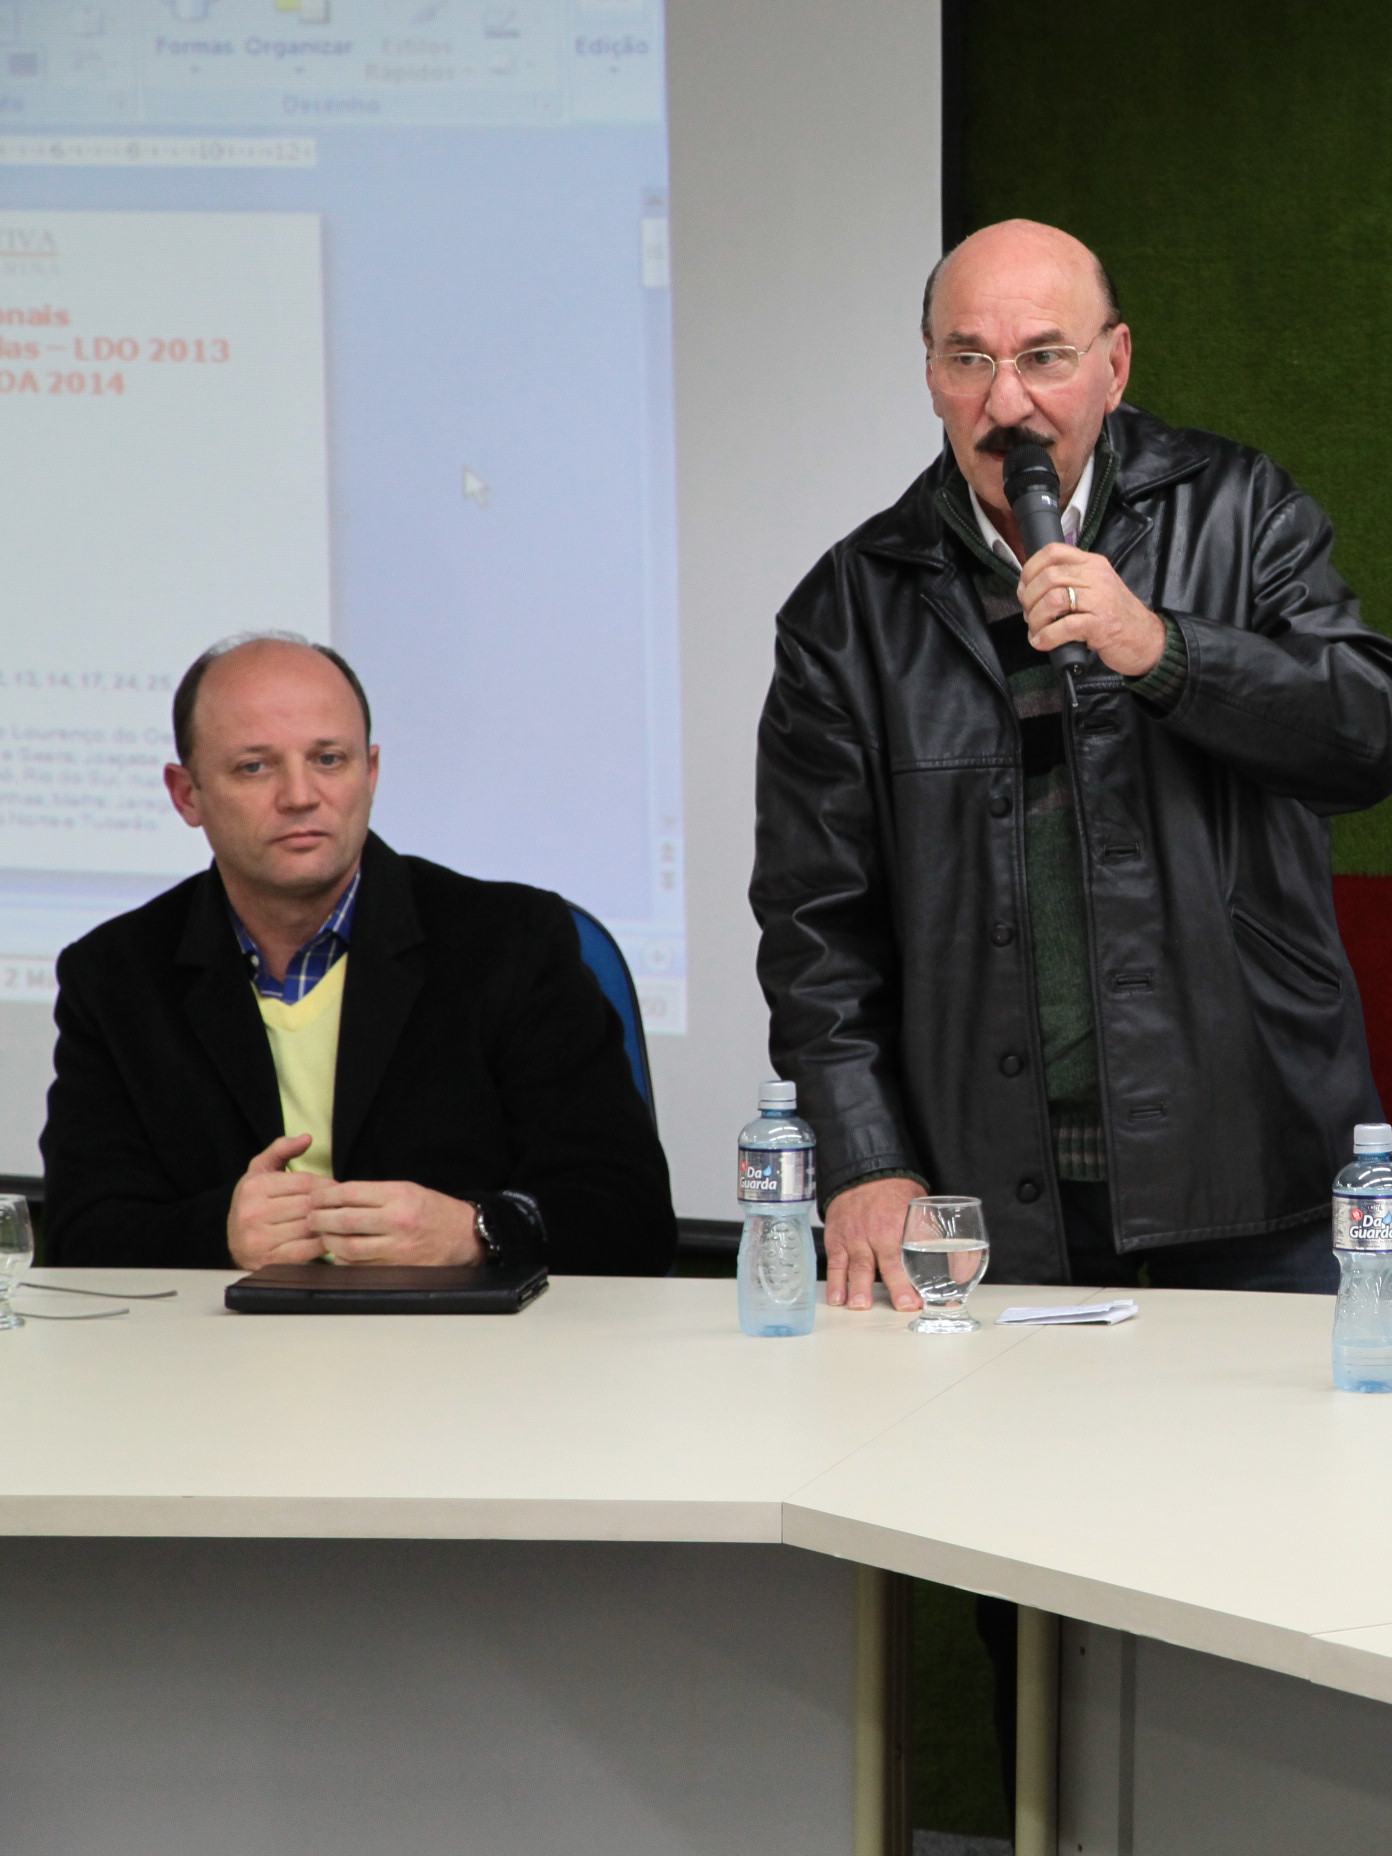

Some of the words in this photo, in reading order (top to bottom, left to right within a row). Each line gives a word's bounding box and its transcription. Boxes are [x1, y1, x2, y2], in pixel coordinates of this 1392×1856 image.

[575, 35, 650, 59] Edição
[72, 336, 142, 363] LDO
[148, 337, 232, 364] 2013
[47, 370, 126, 396] 2014
[747, 1166, 763, 1179] Da
[740, 1176, 778, 1190] Guarda
[1362, 1214, 1383, 1228] Da
